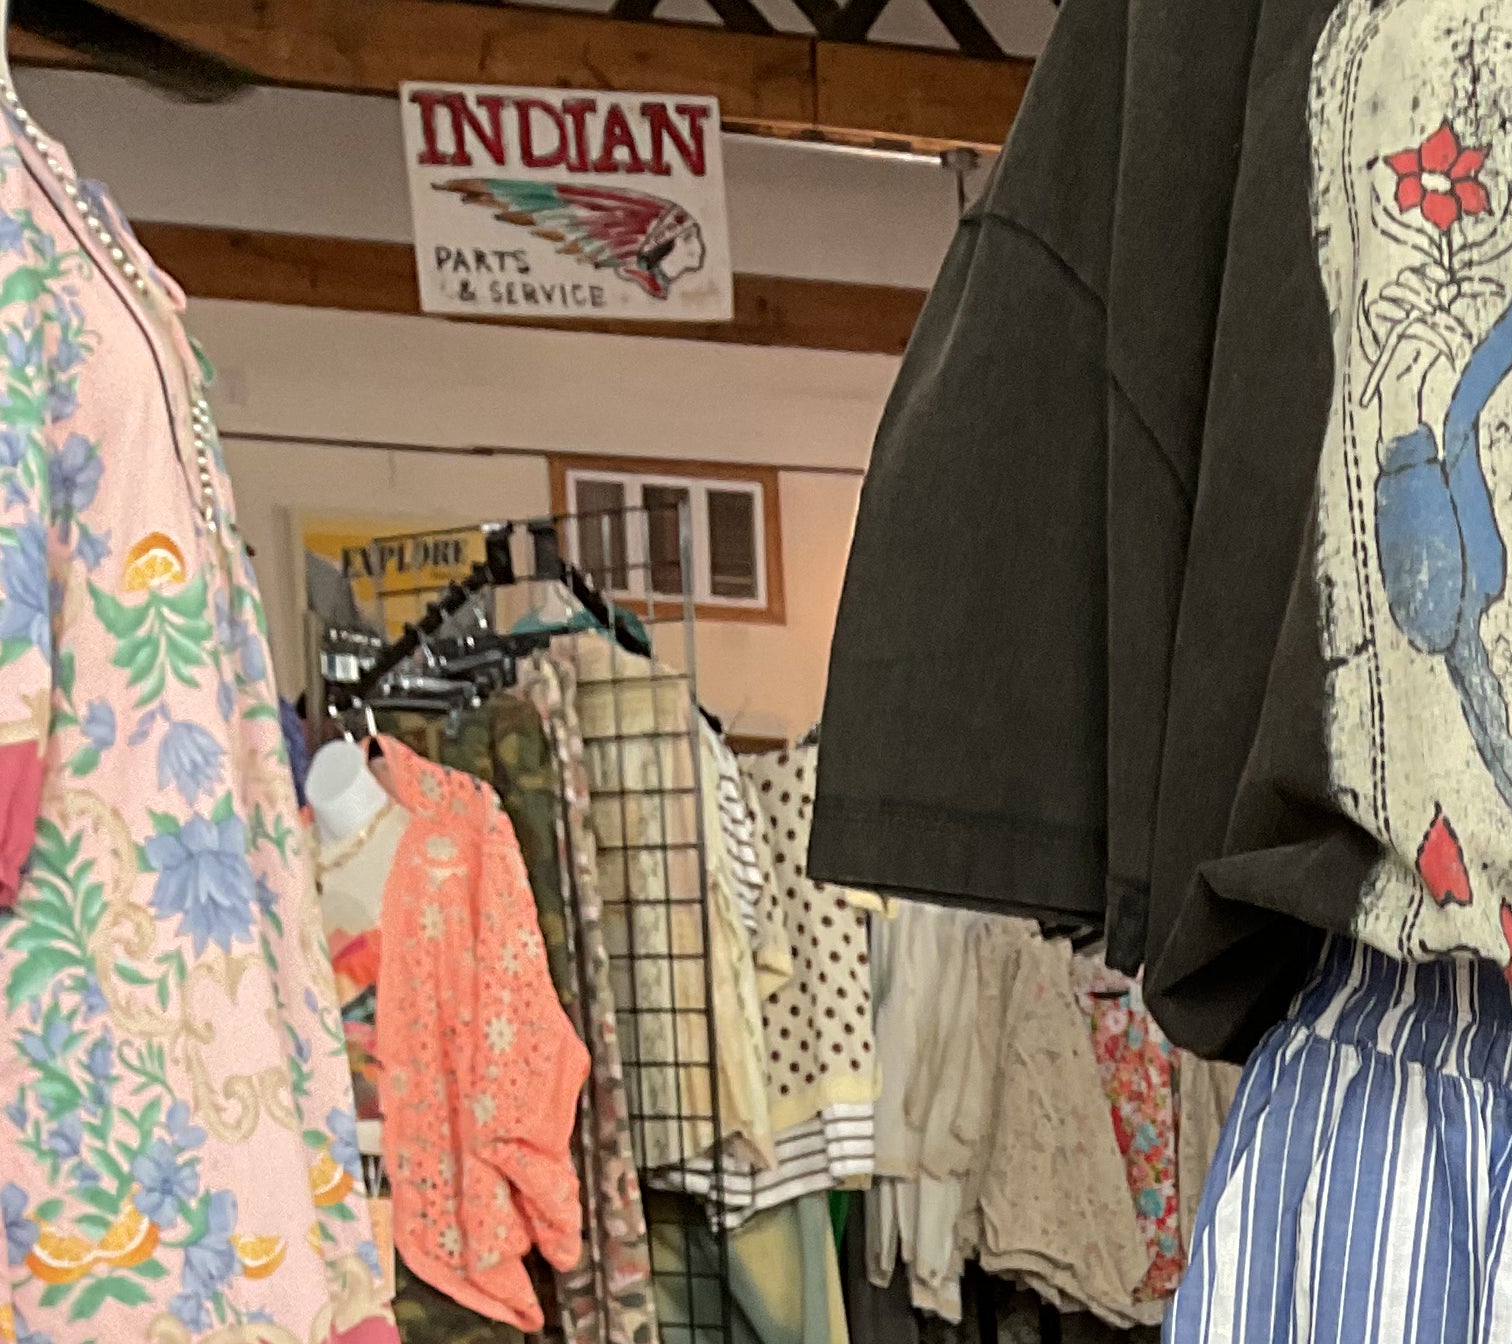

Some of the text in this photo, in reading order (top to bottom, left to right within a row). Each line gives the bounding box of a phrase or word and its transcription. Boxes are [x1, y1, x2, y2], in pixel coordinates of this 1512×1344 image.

[408, 89, 710, 176] INDIAN
[435, 247, 530, 274] PARTS
[457, 279, 605, 308] & SERVICE
